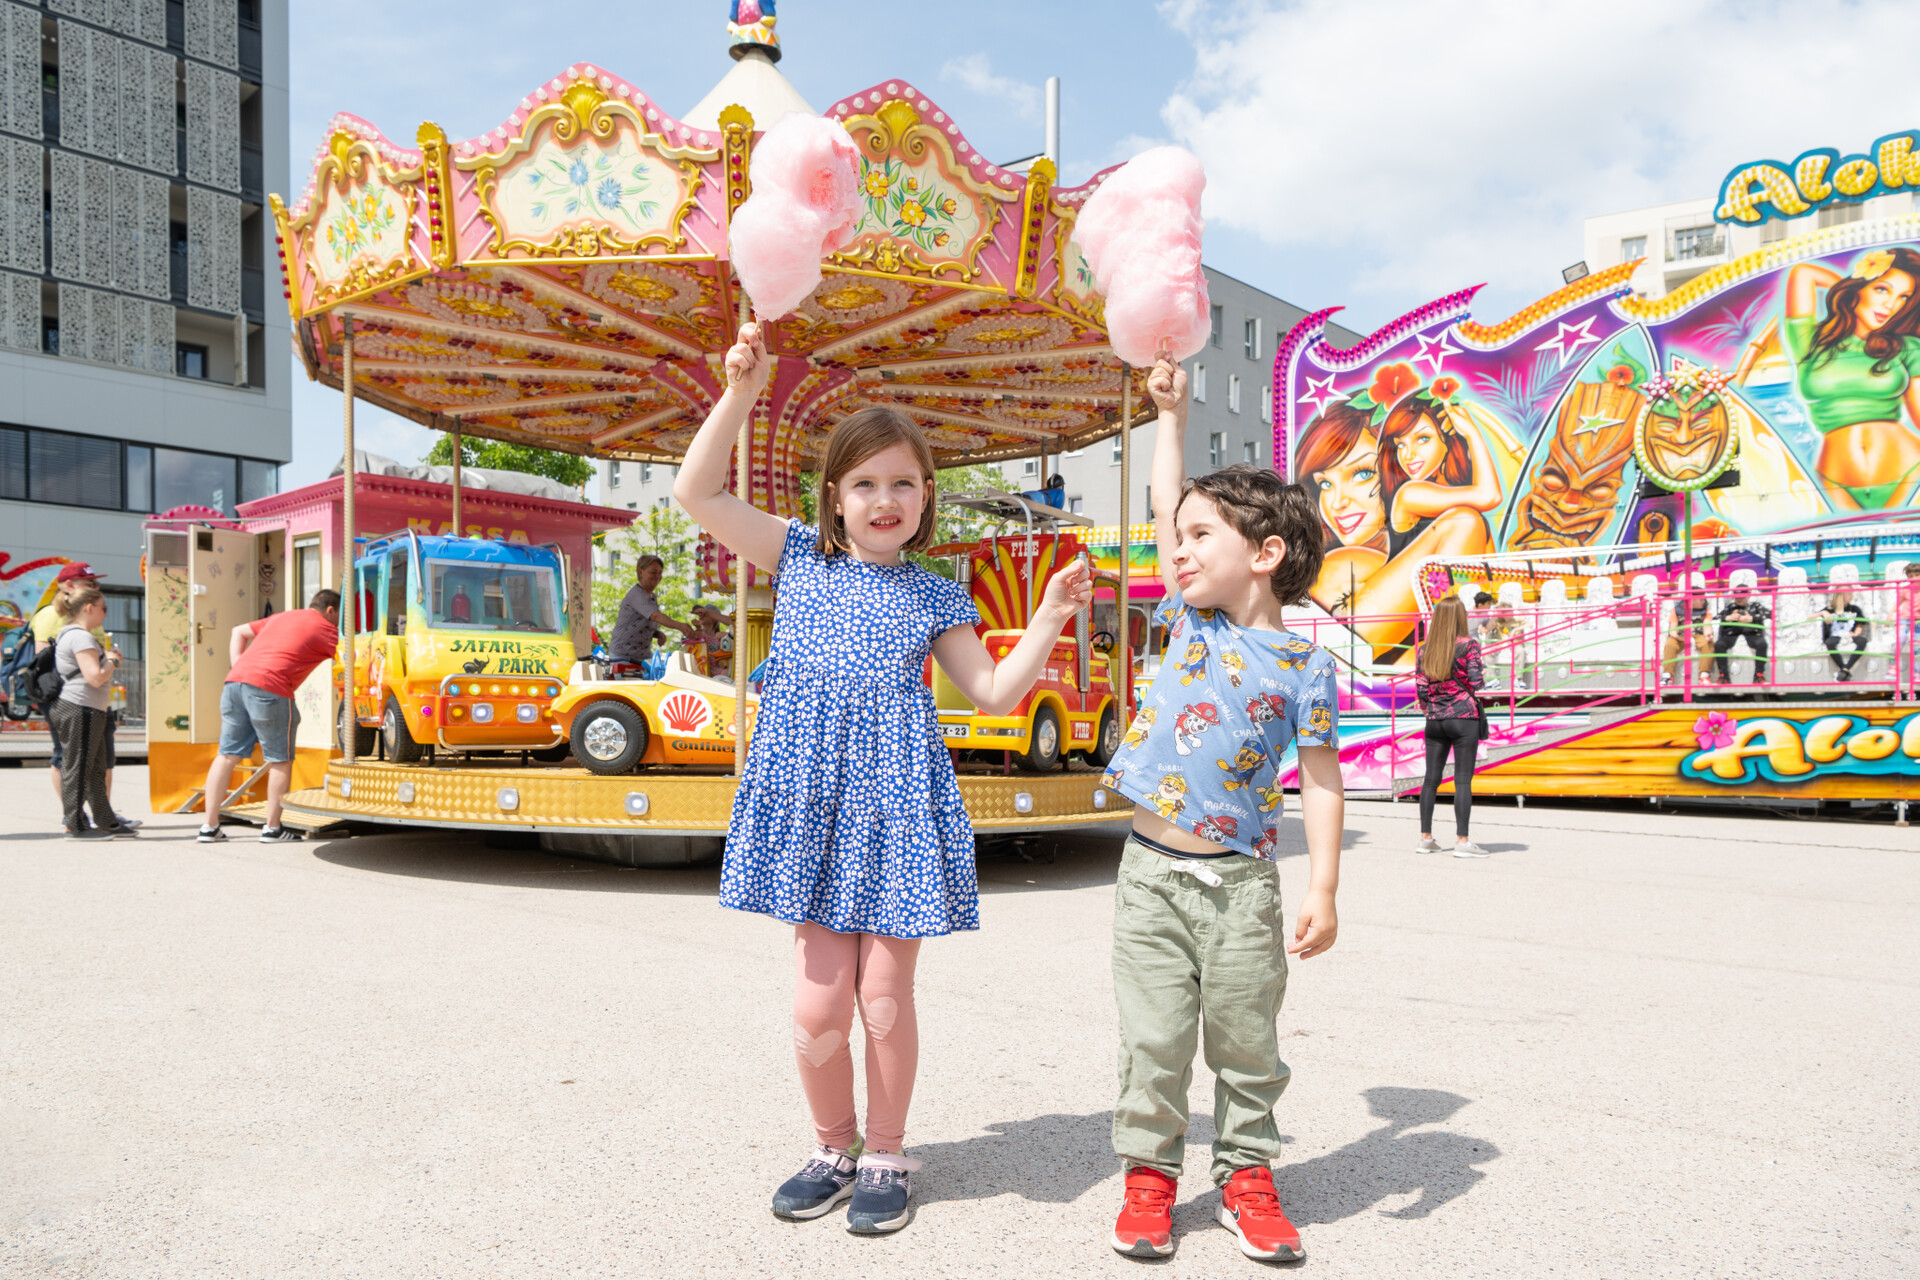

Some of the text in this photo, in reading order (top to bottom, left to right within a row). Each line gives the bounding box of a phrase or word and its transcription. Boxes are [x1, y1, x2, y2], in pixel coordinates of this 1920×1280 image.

[408, 518, 531, 545] KASSA
[450, 640, 521, 654] SAFARI
[498, 658, 549, 674] PARK
[1075, 722, 1090, 738] FIRE
[1233, 729, 1257, 739] CHAS
[1118, 757, 1142, 776] CHASE
[1203, 800, 1249, 820] MARSHALL
